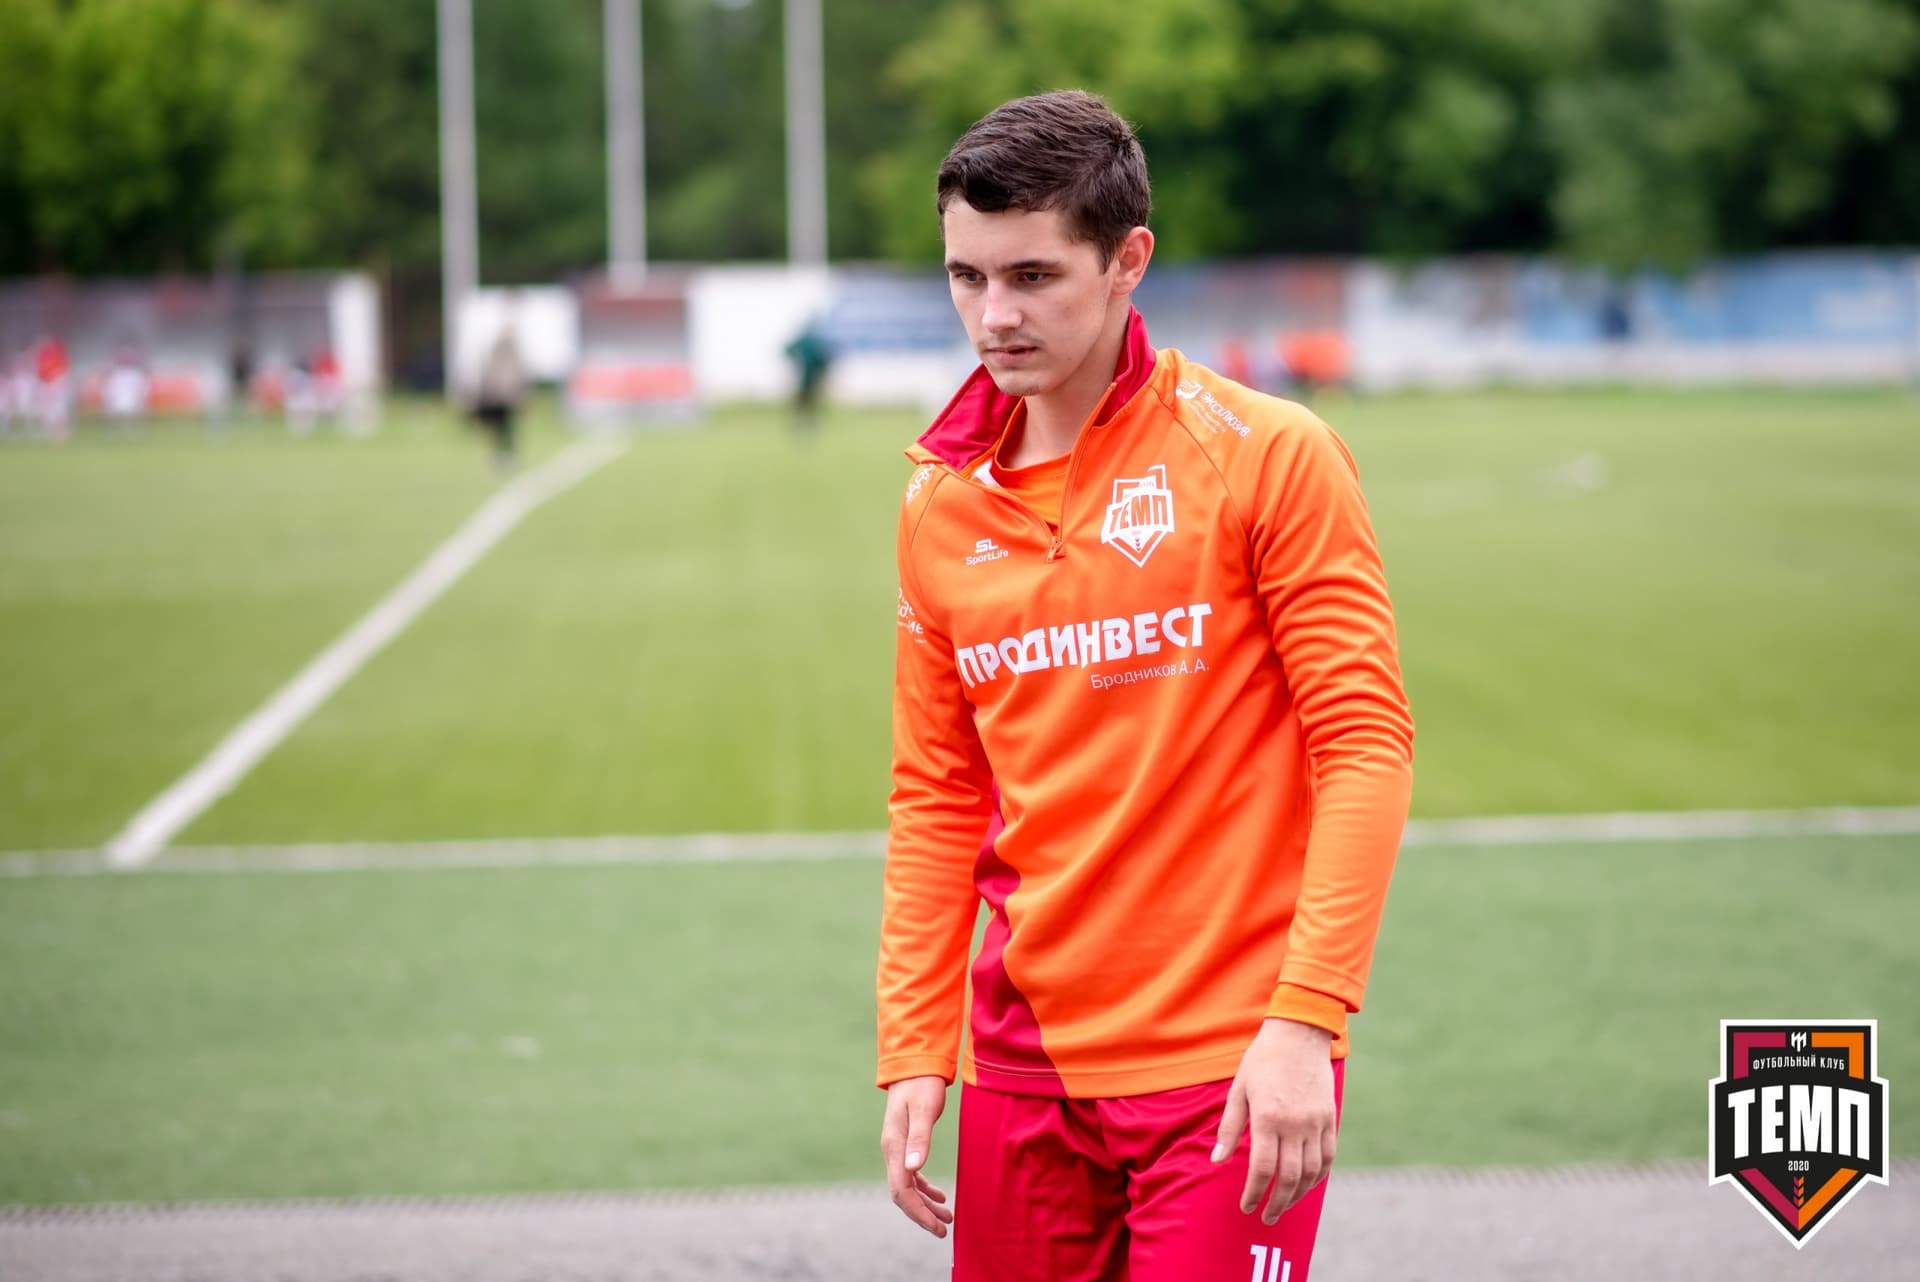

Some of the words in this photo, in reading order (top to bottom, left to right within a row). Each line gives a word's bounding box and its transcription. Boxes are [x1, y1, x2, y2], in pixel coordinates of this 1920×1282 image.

[1109, 494, 1169, 533] ТЕМП
[966, 549, 1009, 566] SportLife
[975, 538, 999, 553] SL
[957, 603, 1213, 689] ПРОДИНВЕСТ
[1090, 664, 1177, 690] Бродников
